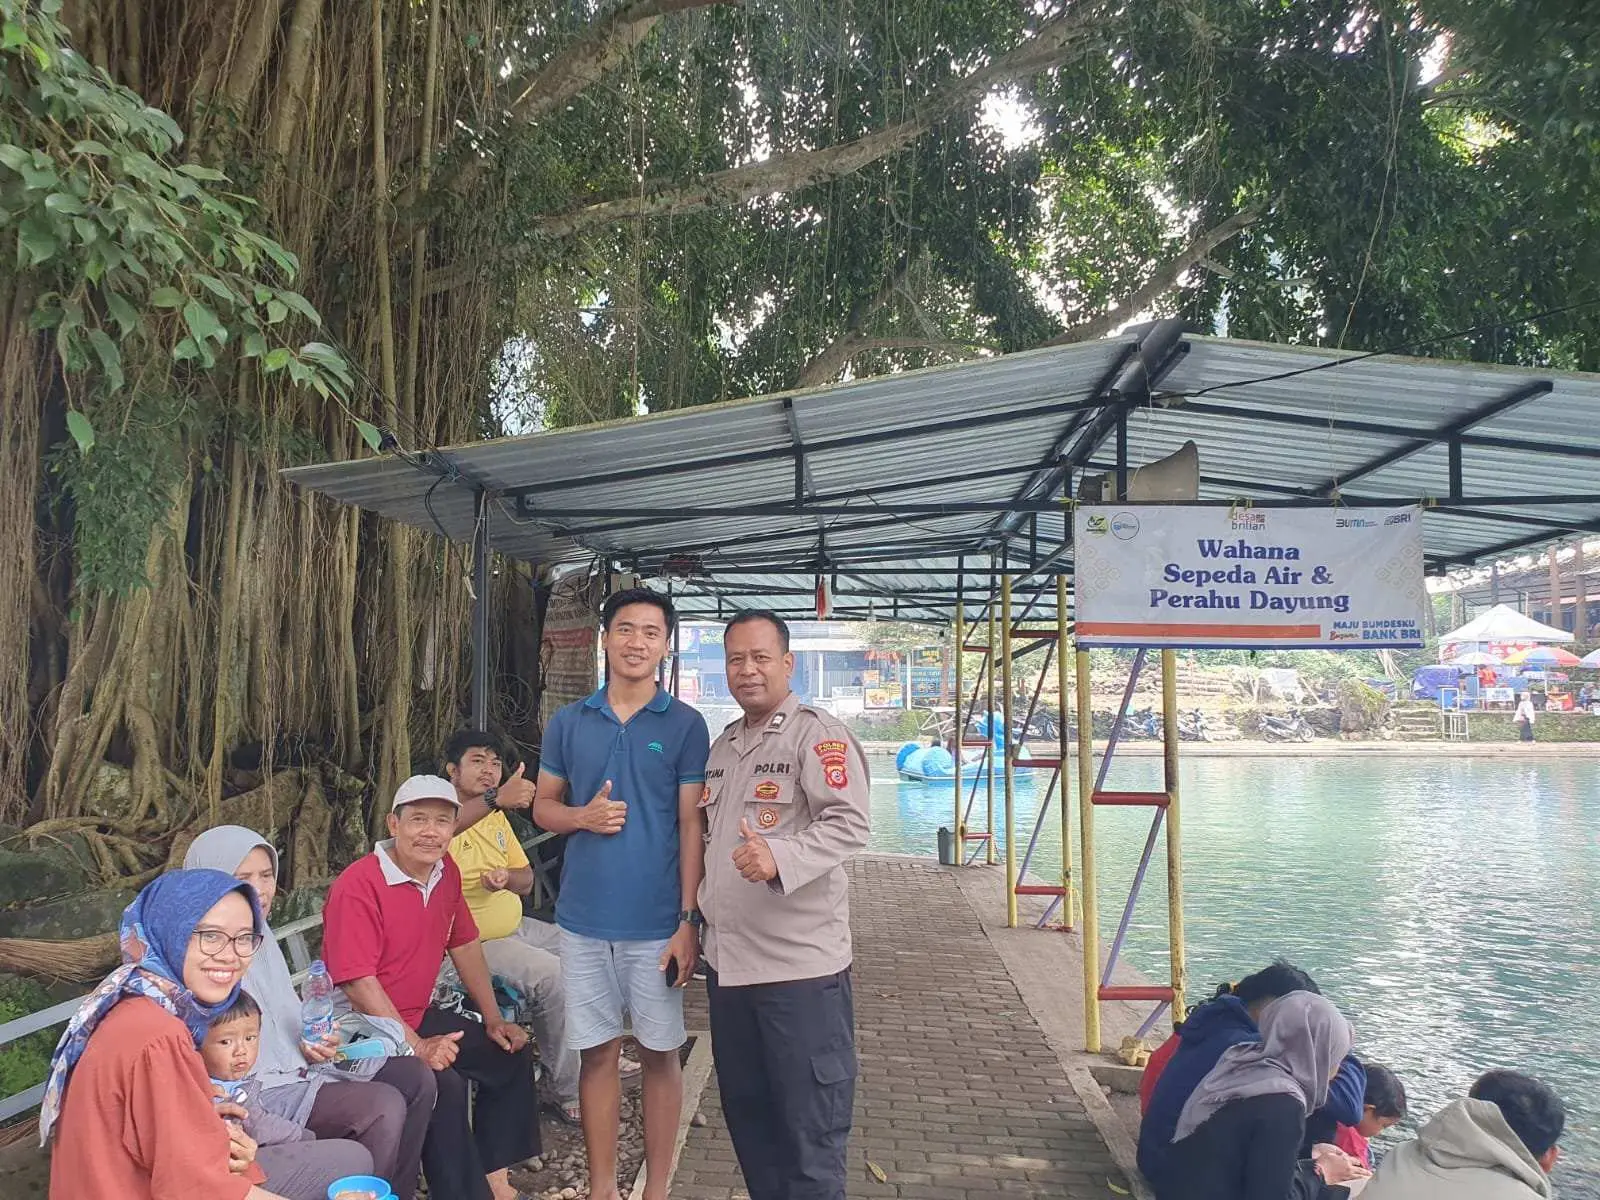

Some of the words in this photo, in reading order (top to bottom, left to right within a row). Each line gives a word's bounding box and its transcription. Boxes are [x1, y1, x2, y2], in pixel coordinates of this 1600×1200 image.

[1197, 539, 1300, 561] Wahana
[1163, 563, 1257, 588] Sepeda
[1264, 566, 1303, 585] Air
[1311, 565, 1335, 585] &
[1150, 588, 1241, 609] Perahu
[1250, 590, 1350, 614] Dayung
[1333, 620, 1360, 629] MAJU
[1361, 620, 1416, 629] BUMDESKU
[1362, 629, 1398, 640] BANK
[1400, 628, 1422, 639] BRI
[754, 763, 792, 775] POLRI
